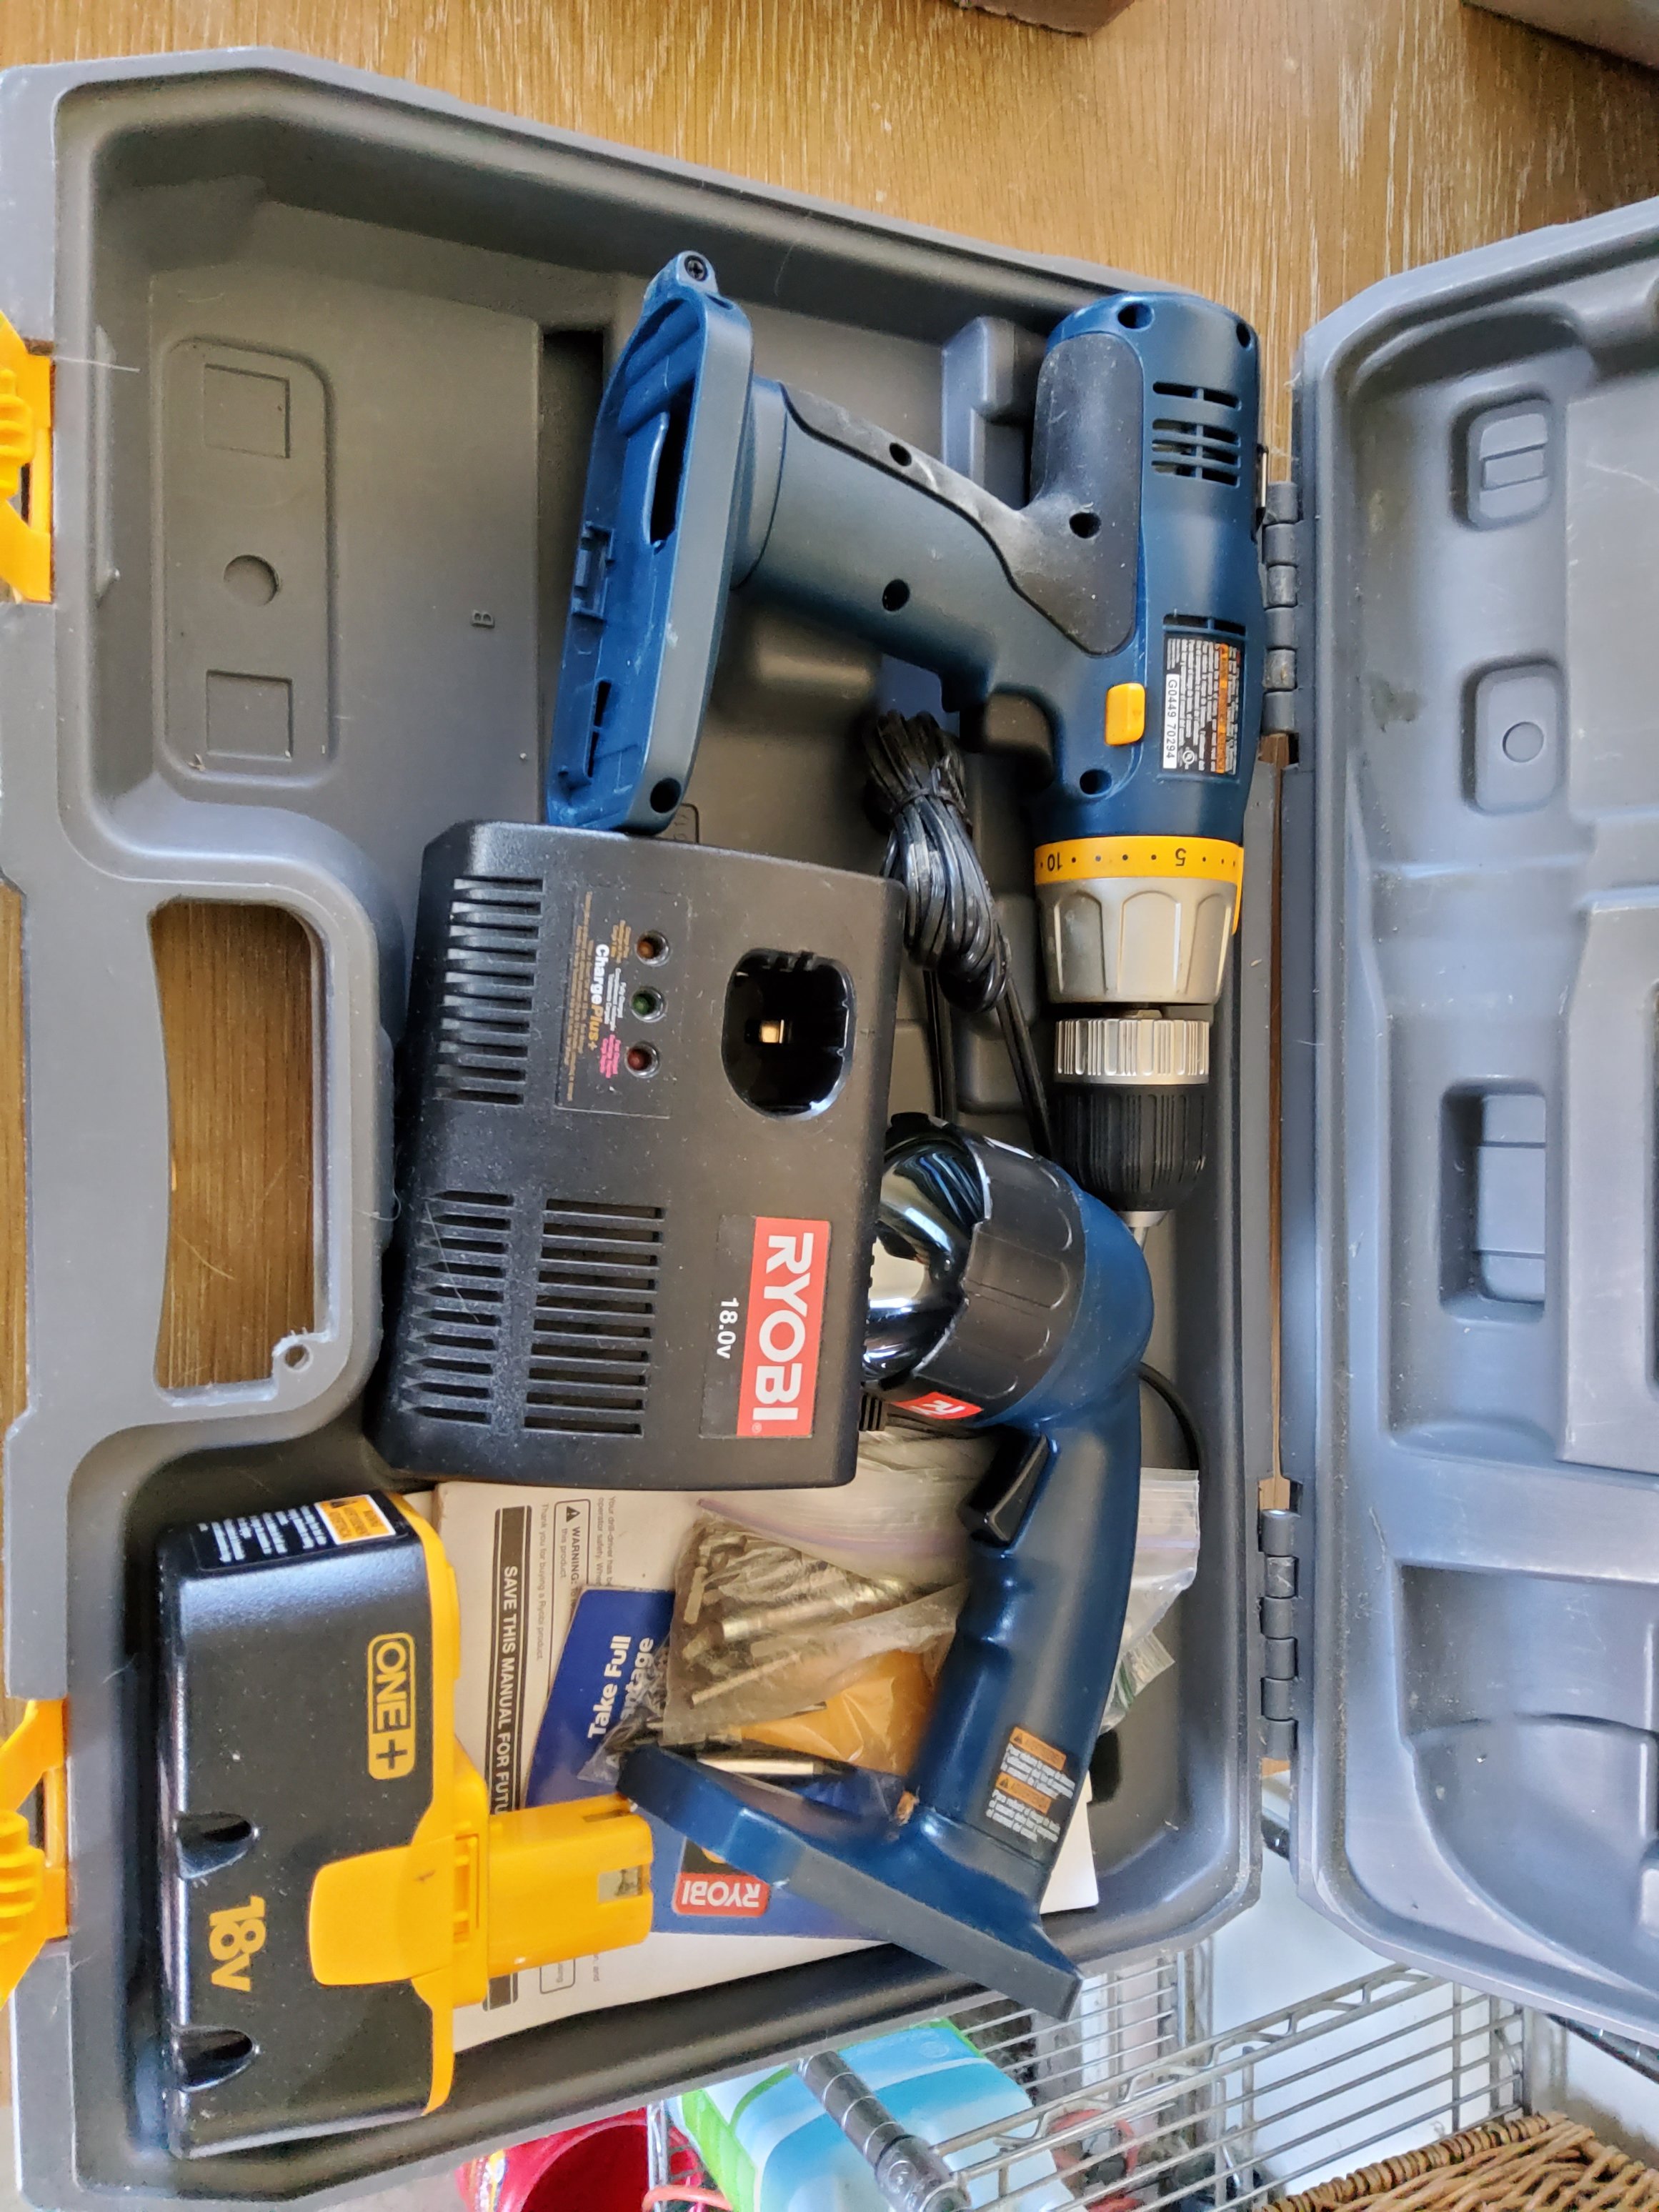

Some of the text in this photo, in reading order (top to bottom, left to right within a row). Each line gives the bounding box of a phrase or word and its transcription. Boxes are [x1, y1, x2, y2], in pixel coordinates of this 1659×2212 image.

[1167, 679, 1177, 717] G0449
[1166, 724, 1176, 759] 70294
[1047, 847, 1186, 872] 10 5
[753, 1232, 814, 1421] RYOBI
[571, 1526, 581, 1584] WARNING:
[504, 1565, 517, 1610] SAVE
[502, 1613, 517, 1655] THIS
[497, 1657, 515, 1730] MANUAL
[587, 1635, 632, 1738] Take Full
[496, 1732, 512, 1768] FOR
[682, 1880, 762, 1908] RYOBI
